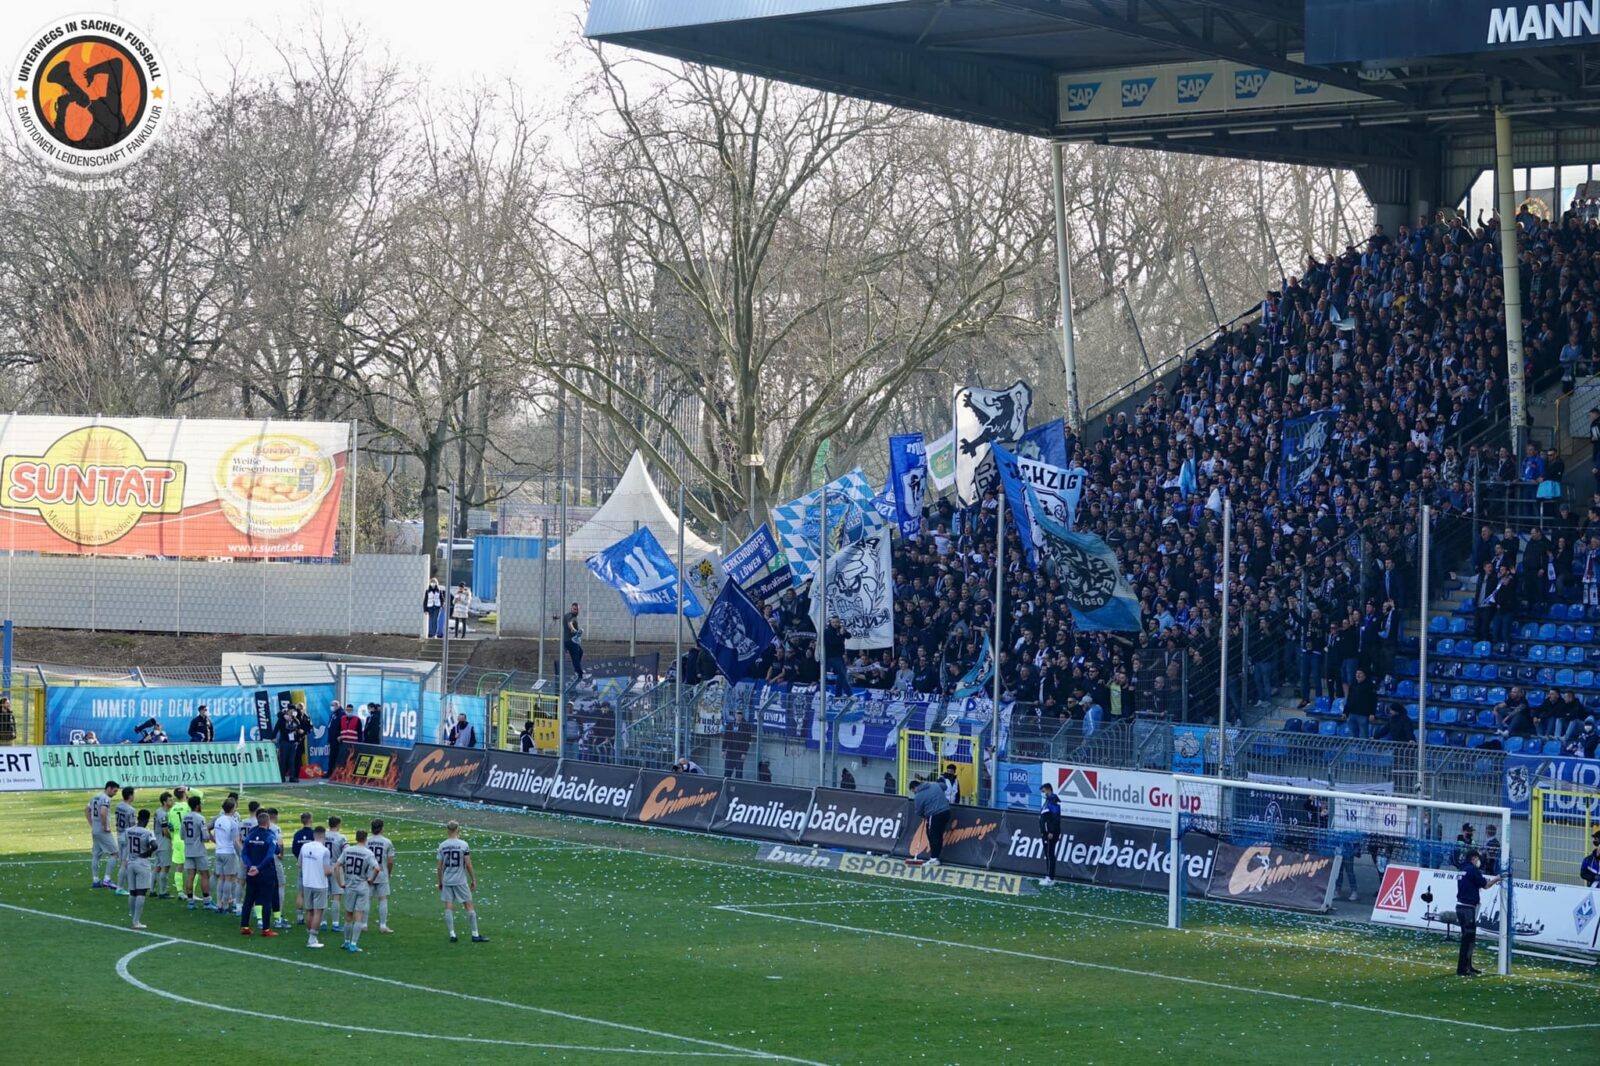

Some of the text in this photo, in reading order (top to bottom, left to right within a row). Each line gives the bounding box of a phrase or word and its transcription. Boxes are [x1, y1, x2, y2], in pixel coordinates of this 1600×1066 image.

[1122, 83, 1149, 102] SAP
[1178, 80, 1204, 98] SAP
[1236, 75, 1264, 94] SAP
[1068, 87, 1094, 106] SAP
[10, 462, 174, 507] SUNTAT
[104, 513, 137, 539] Products
[227, 543, 305, 553] www.suntat.de
[740, 555, 762, 579] LÖWEN
[92, 699, 135, 718] IMMER
[140, 700, 162, 718] AUF
[169, 699, 193, 717] DEM
[257, 700, 267, 729] bwin
[66, 749, 253, 768] A. Oberdorf Dienstleistungen
[121, 771, 206, 783] Wir machen DAS
[1009, 771, 1028, 783] 1860
[93, 801, 99, 817] 6
[183, 821, 194, 838] 16
[128, 836, 141, 854] 19
[346, 856, 364, 876] 28
[767, 844, 1016, 893] bwin SPORTWETTEN
